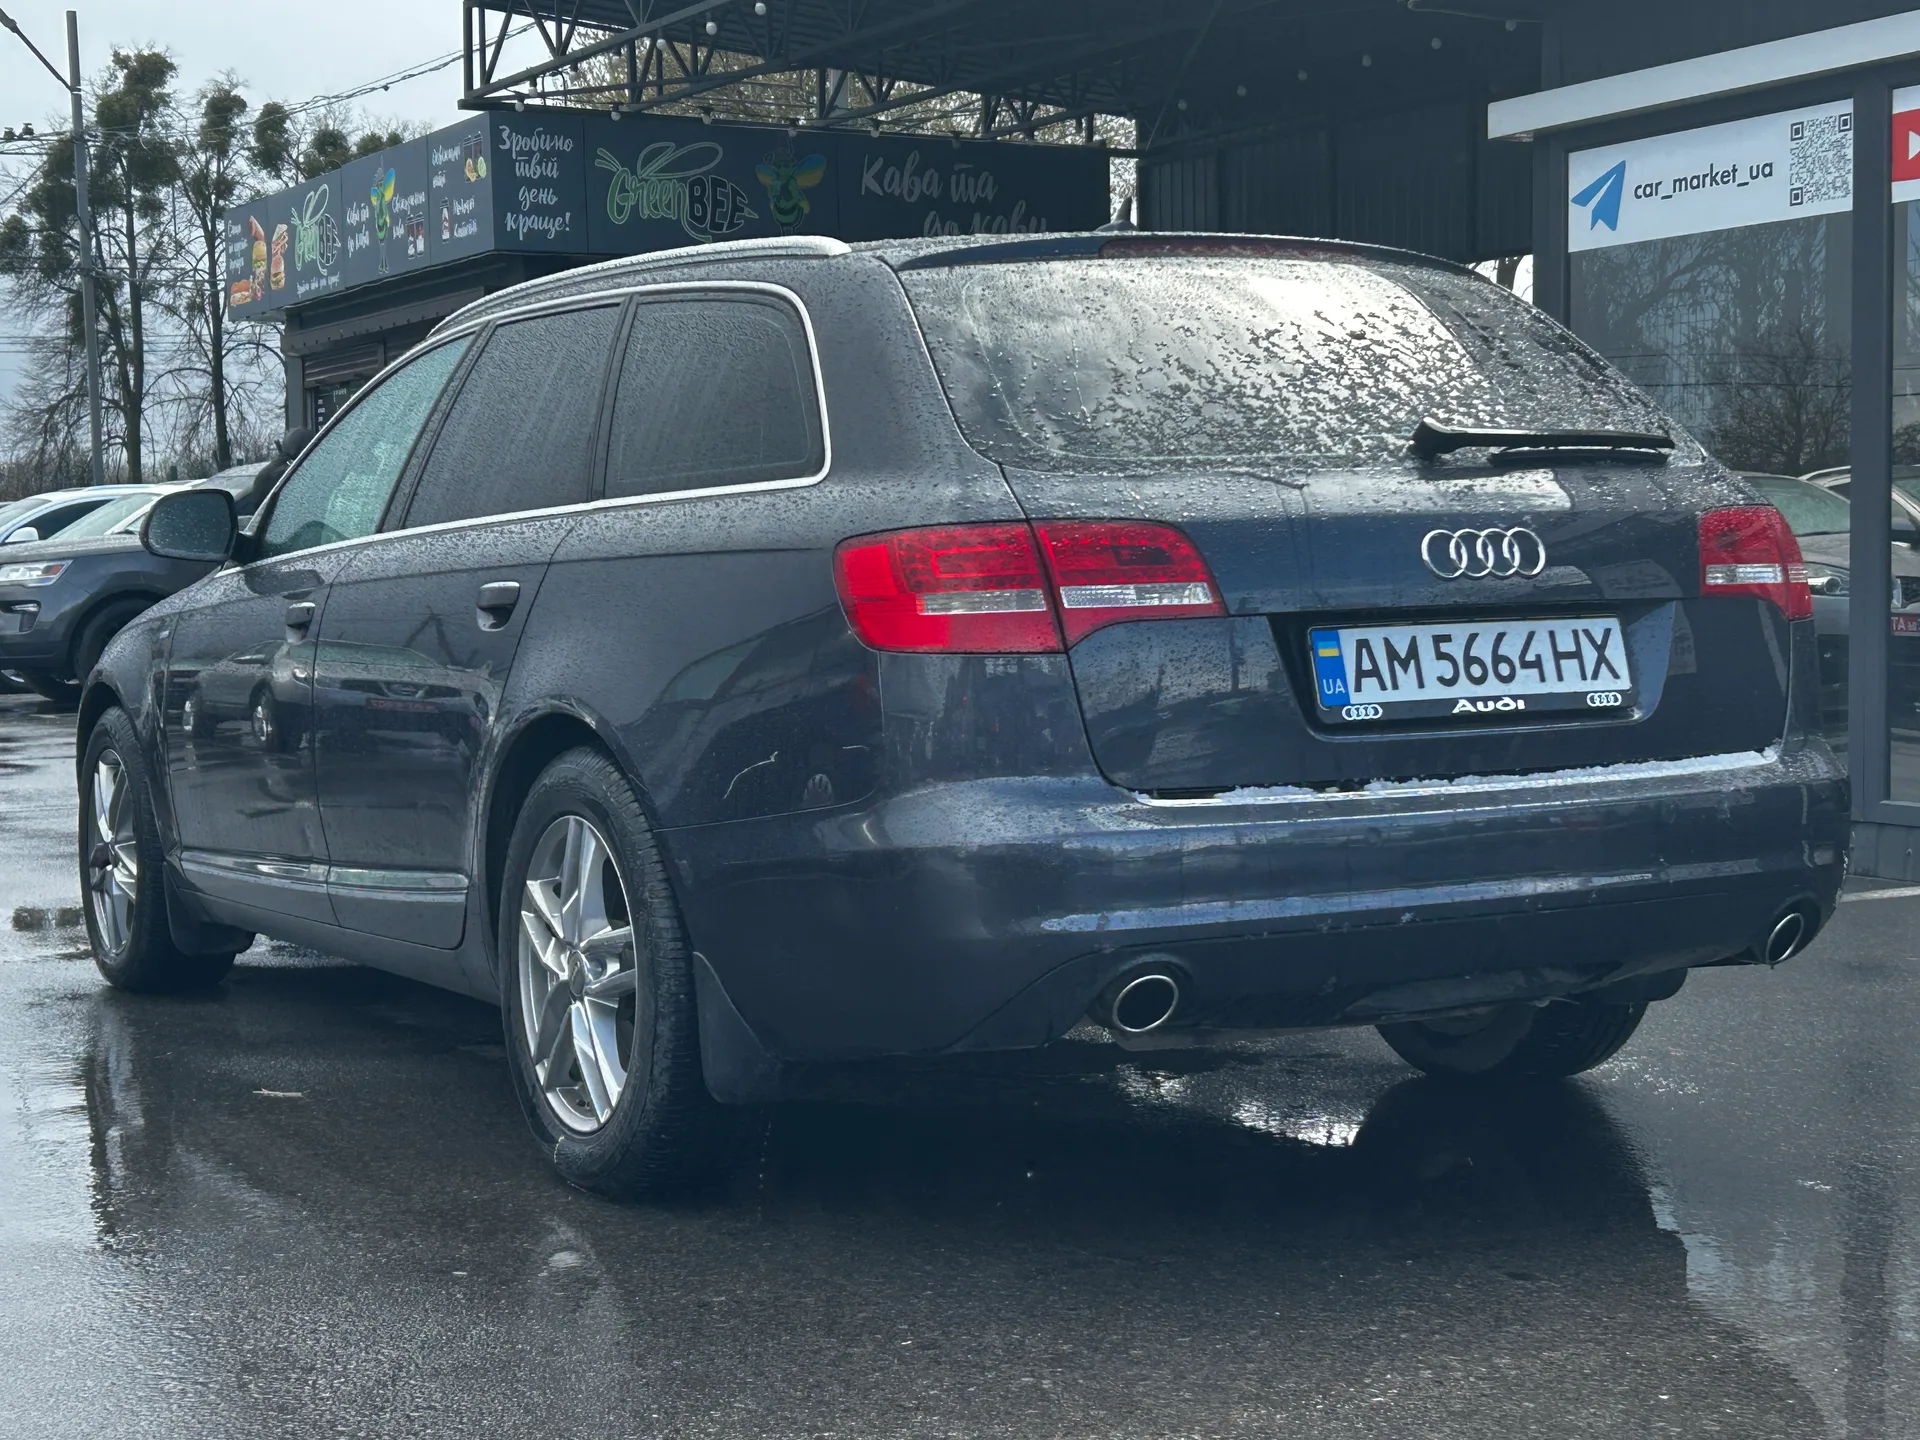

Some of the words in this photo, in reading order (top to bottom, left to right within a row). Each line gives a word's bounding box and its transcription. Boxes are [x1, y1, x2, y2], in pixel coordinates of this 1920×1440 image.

[515, 152, 559, 179] твій
[861, 150, 943, 203] Кава
[1634, 161, 1774, 200] car_market_ua
[518, 185, 558, 211] день
[504, 212, 571, 241] краще!
[1323, 677, 1346, 695] UA
